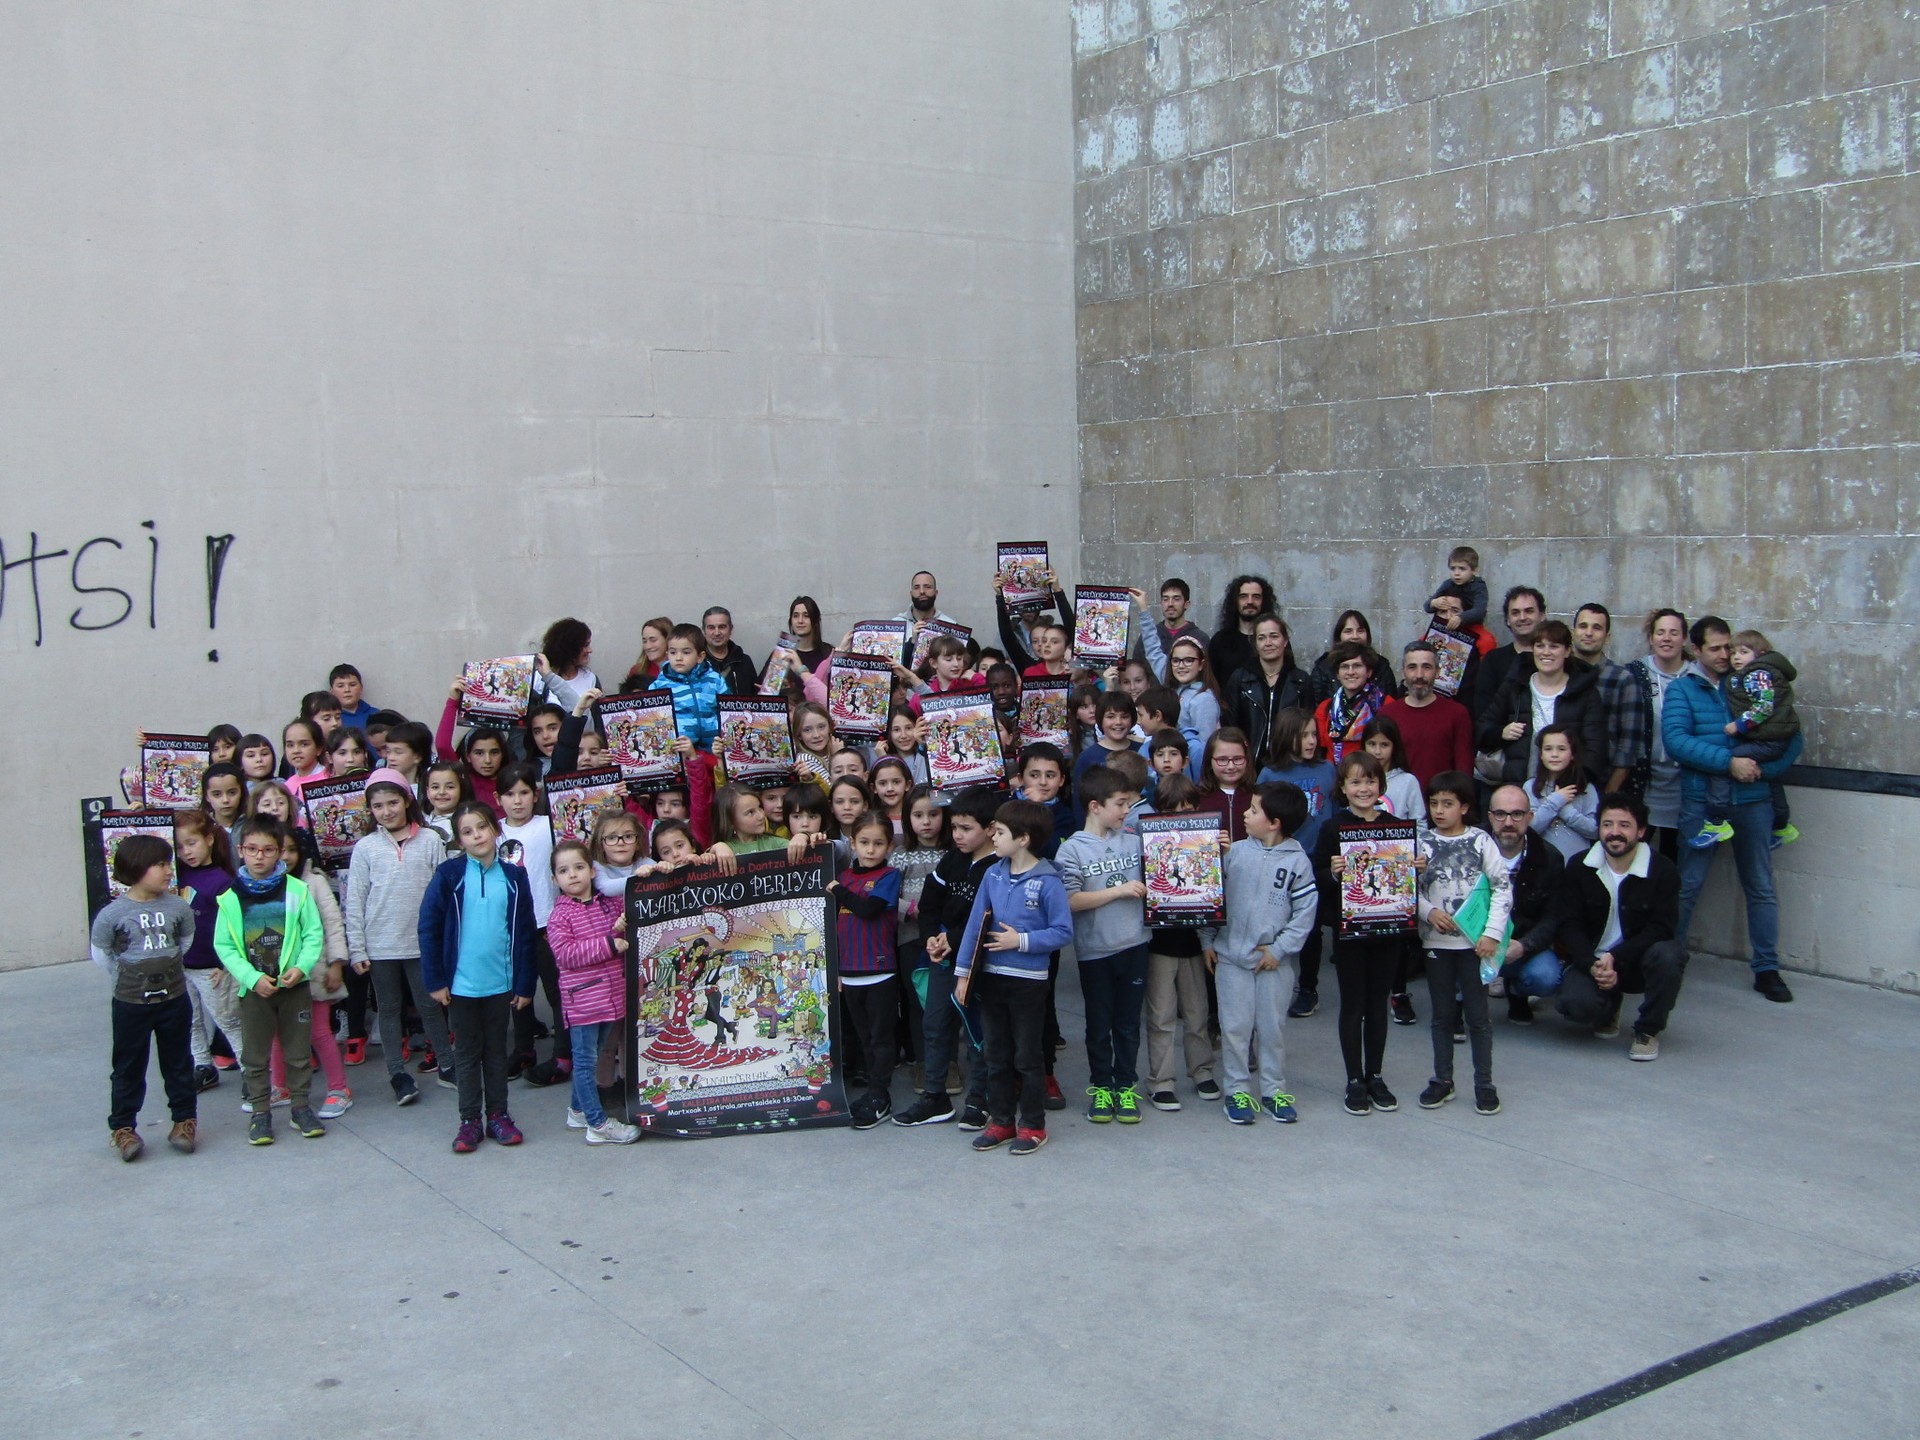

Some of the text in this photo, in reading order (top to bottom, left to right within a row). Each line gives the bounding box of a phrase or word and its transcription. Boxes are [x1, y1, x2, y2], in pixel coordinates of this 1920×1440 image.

[1142, 820, 1187, 831] MARTXOKO
[634, 877, 684, 893] Zumaiako
[748, 860, 786, 873] Dantza
[1082, 853, 1139, 877] CELTICS
[634, 868, 823, 920] MARTXOKO PERIYA
[667, 1108, 702, 1116] Martxoak
